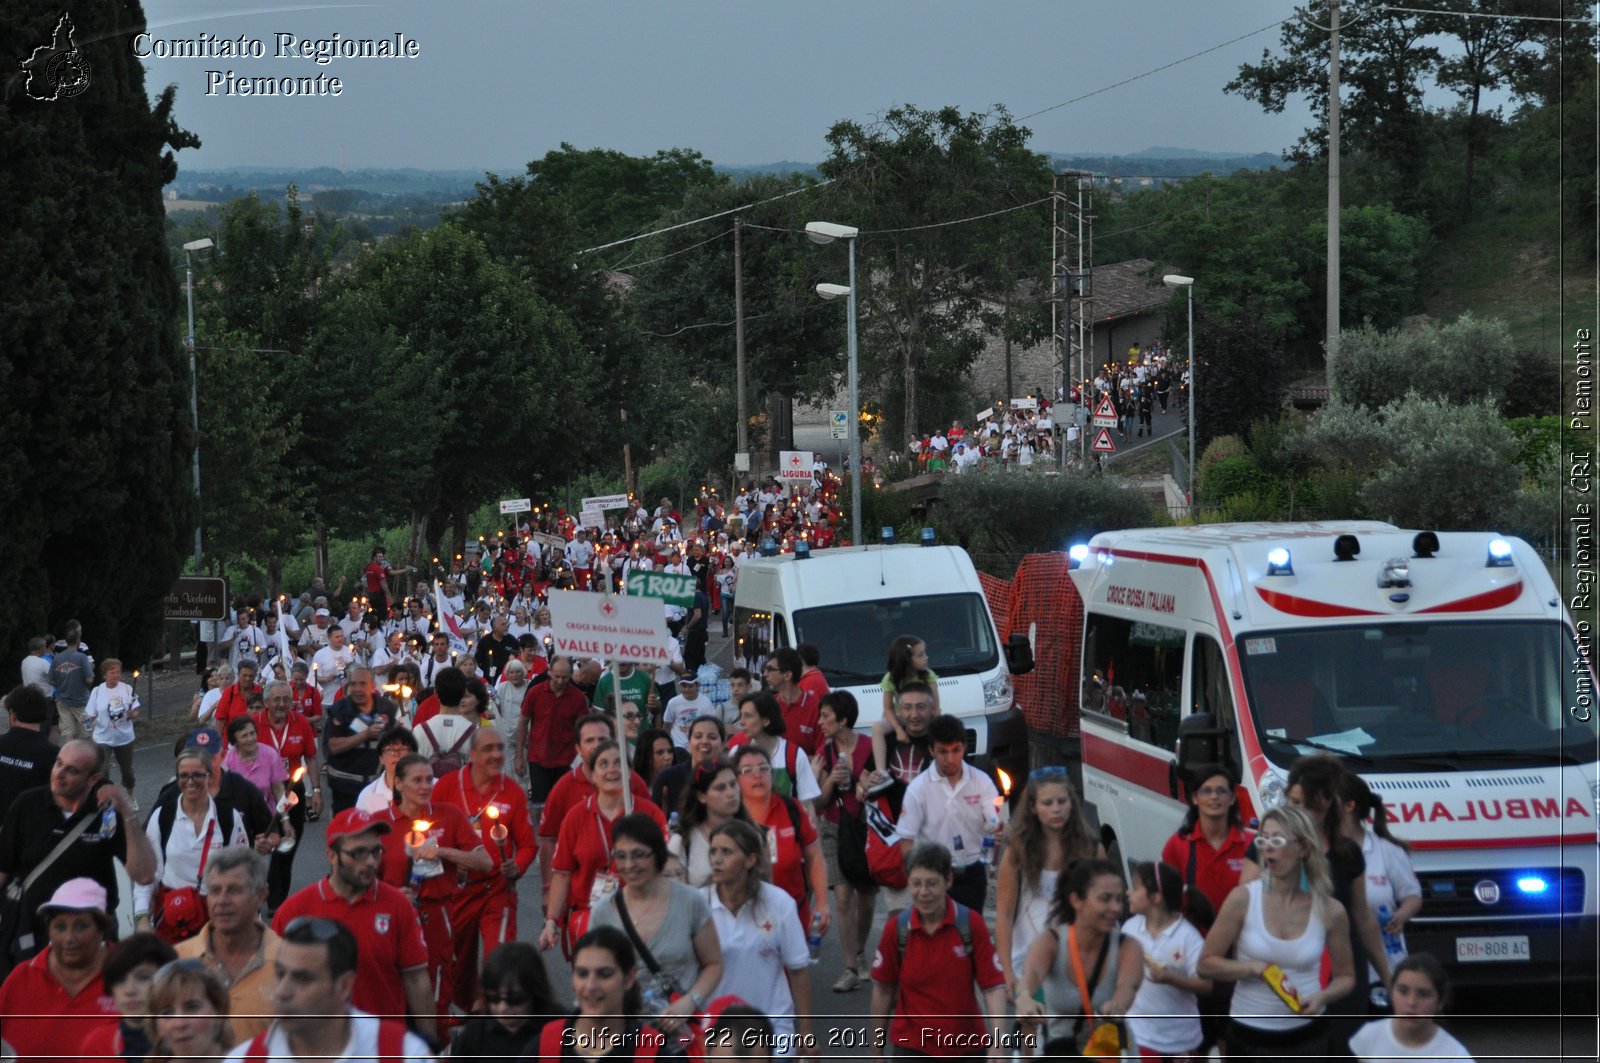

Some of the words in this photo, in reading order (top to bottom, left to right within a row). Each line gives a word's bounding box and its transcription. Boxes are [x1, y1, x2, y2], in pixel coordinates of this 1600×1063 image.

[782, 470, 812, 478] LIGURIA
[182, 592, 217, 604] Vedetta
[1106, 585, 1126, 605] CROCE
[1127, 587, 1145, 609] ROSSA
[1146, 591, 1175, 614] ITALIANA
[566, 622, 590, 631] CROCE
[592, 623, 617, 633] ROSSA
[620, 626, 655, 636] ITALIANA
[558, 638, 599, 654] VALLE
[604, 643, 668, 660] D'AOSTA
[14, 759, 34, 769] ITALIANA
[1481, 887, 1496, 898] FIAT
[1459, 943, 1478, 956] CRI
[1485, 942, 1508, 955] 808
[1513, 941, 1529, 955] AC
